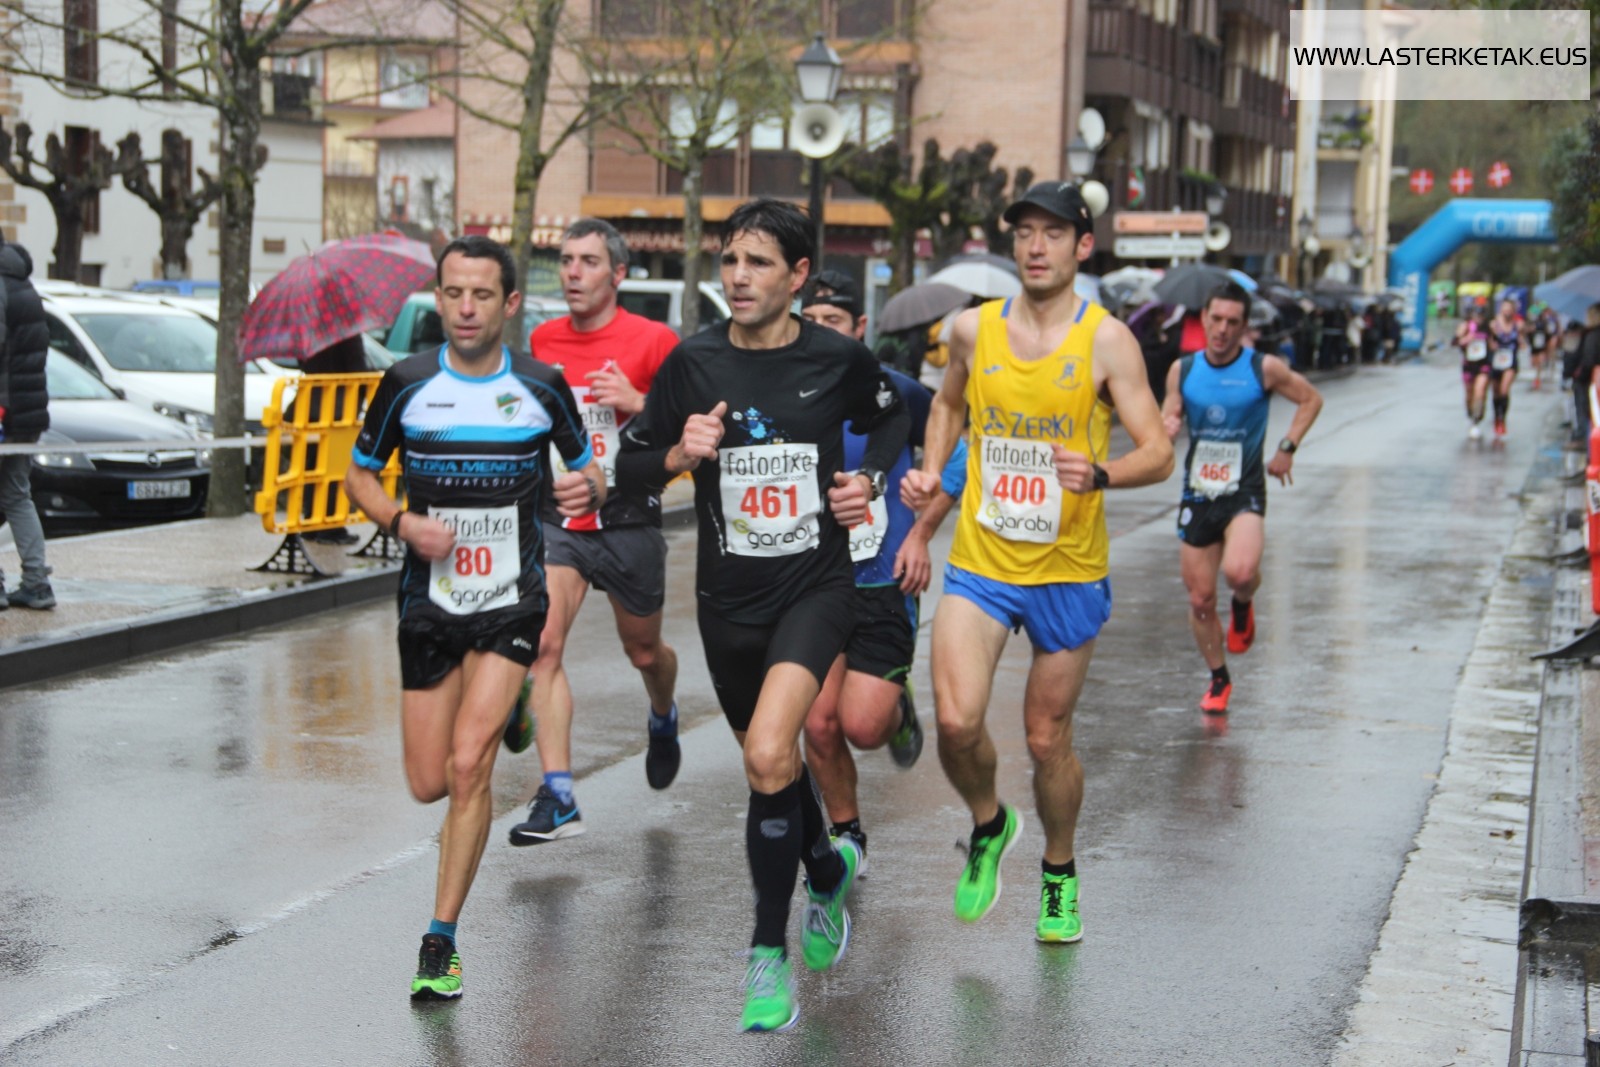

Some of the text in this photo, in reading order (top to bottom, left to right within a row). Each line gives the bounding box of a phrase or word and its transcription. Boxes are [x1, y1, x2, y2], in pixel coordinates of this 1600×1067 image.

[1010, 412, 1073, 438] ZERKI
[725, 450, 813, 476] fotoetxe
[1199, 463, 1230, 481] 466
[740, 484, 798, 519] 461
[993, 474, 1046, 505] 400
[994, 514, 1052, 532] garabi
[455, 546, 492, 577] 80
